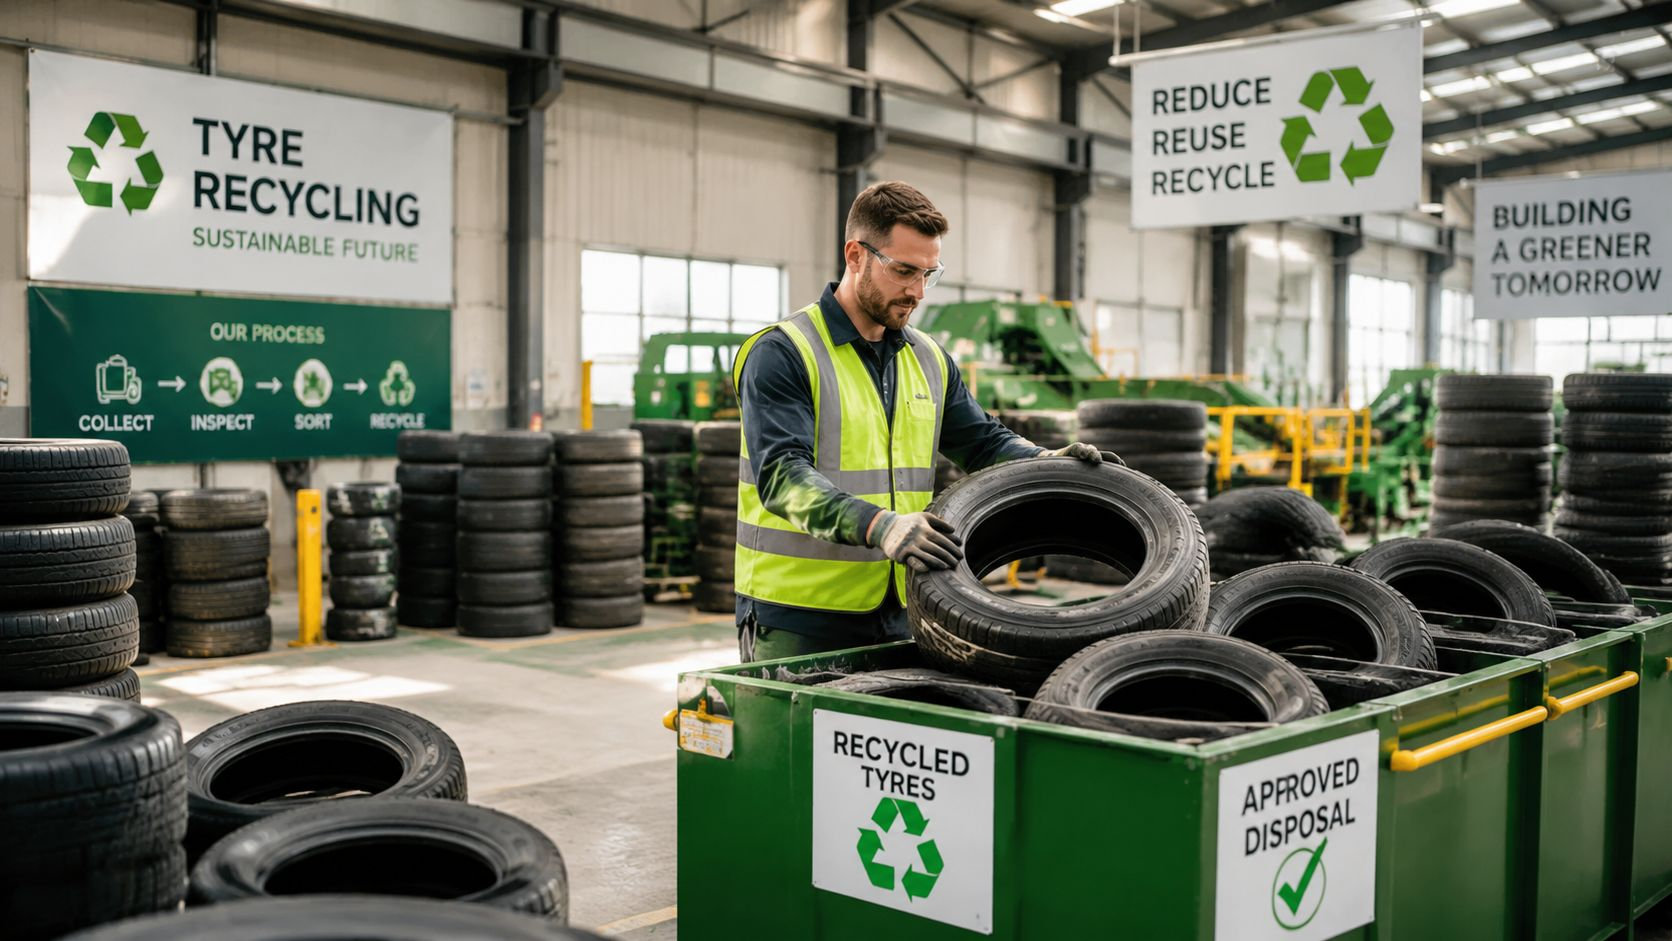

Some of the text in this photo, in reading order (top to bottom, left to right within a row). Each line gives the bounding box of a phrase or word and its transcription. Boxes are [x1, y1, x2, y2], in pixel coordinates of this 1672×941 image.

[1152, 76, 1271, 115] REDUCE
[192, 117, 303, 168] TYRE
[1152, 122, 1246, 156] REUSE
[1152, 160, 1275, 195] RECYCLE
[193, 170, 419, 230] RECYCLING
[1493, 195, 1632, 229] BUILDING
[192, 227, 419, 265] SUSTAINABLE FUTURE
[1491, 231, 1652, 263] A GREENER
[1491, 266, 1663, 297] TOMORROW
[210, 322, 325, 344] OUR PROCESS
[78, 414, 155, 433] COLLECT
[191, 413, 255, 431] INSPECT
[294, 412, 334, 430] SORT
[370, 412, 425, 430] RECYCLE
[833, 730, 970, 777] RECYCLED
[860, 765, 936, 801] TYRES
[1241, 757, 1360, 816] APPROVED
[1244, 798, 1356, 856] DISPOSAL
